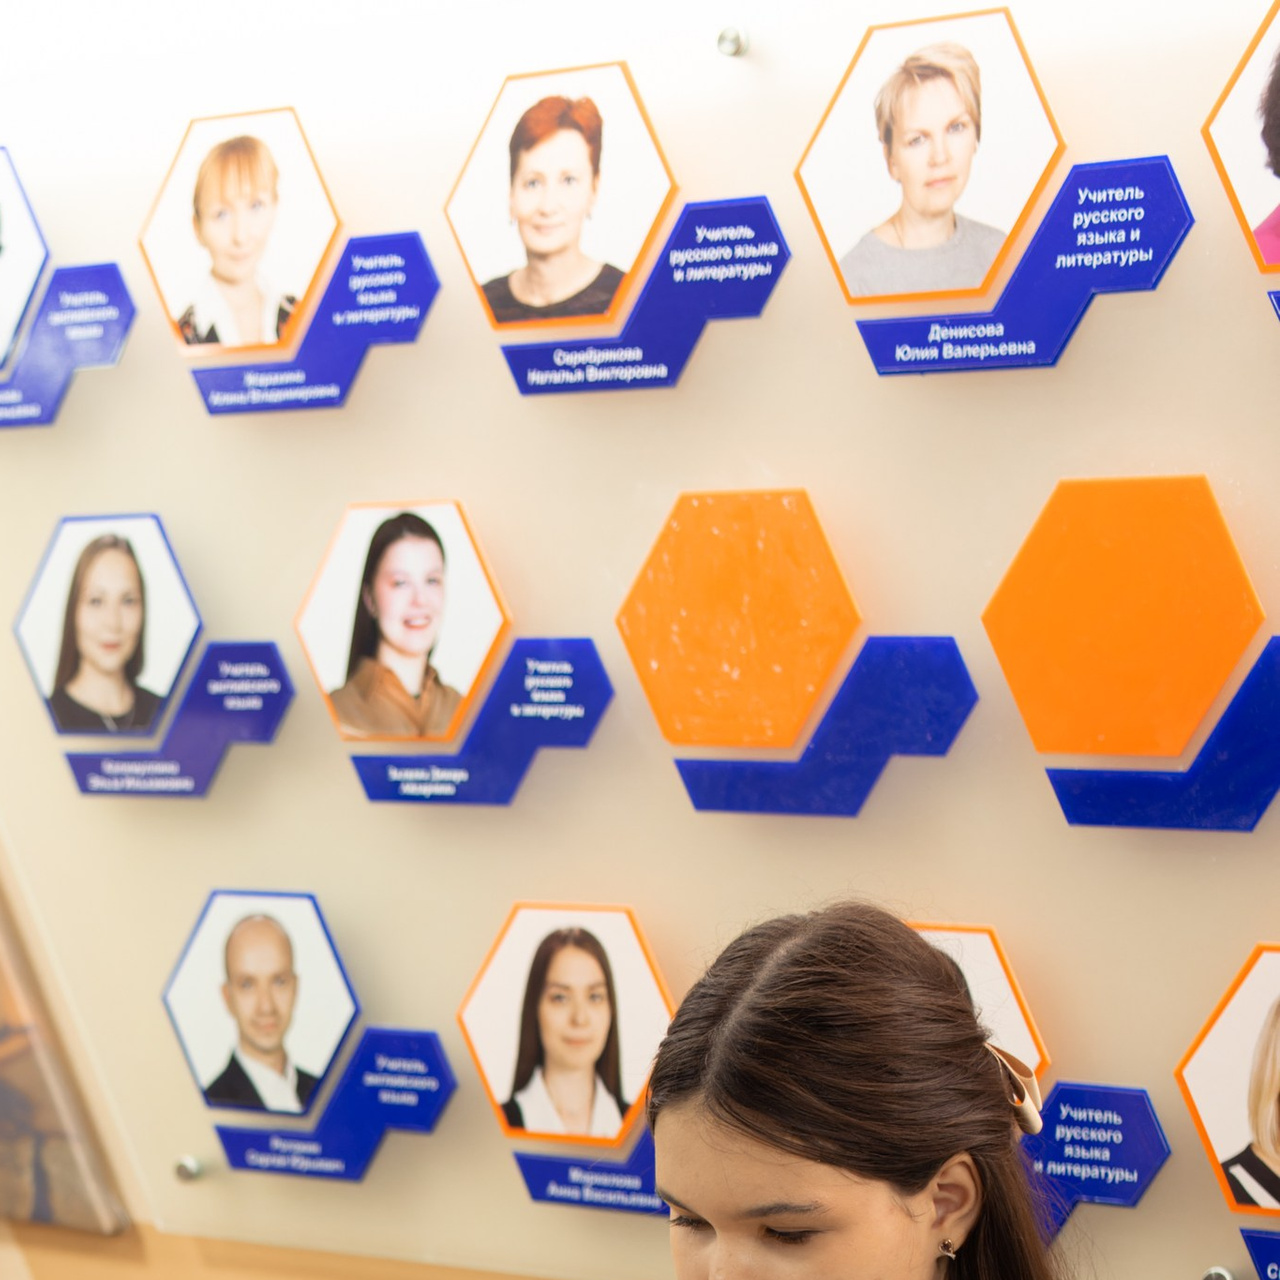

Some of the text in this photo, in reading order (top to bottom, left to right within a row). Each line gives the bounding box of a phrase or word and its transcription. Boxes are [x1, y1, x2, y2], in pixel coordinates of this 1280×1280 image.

[1078, 187, 1144, 204] Учитель
[1073, 206, 1144, 229] русского
[695, 226, 754, 243] Учитель
[1076, 228, 1140, 246] языка и
[670, 242, 778, 267] русского языка
[1055, 248, 1153, 269] литературы
[673, 262, 771, 282] и литературы
[928, 323, 1004, 342] Денисова
[895, 340, 1036, 361] Юлия Валерьевна
[1060, 1103, 1122, 1124] Учитель
[1056, 1124, 1122, 1143] русского
[1065, 1144, 1110, 1161] языка
[1047, 1162, 1138, 1183] литературы
